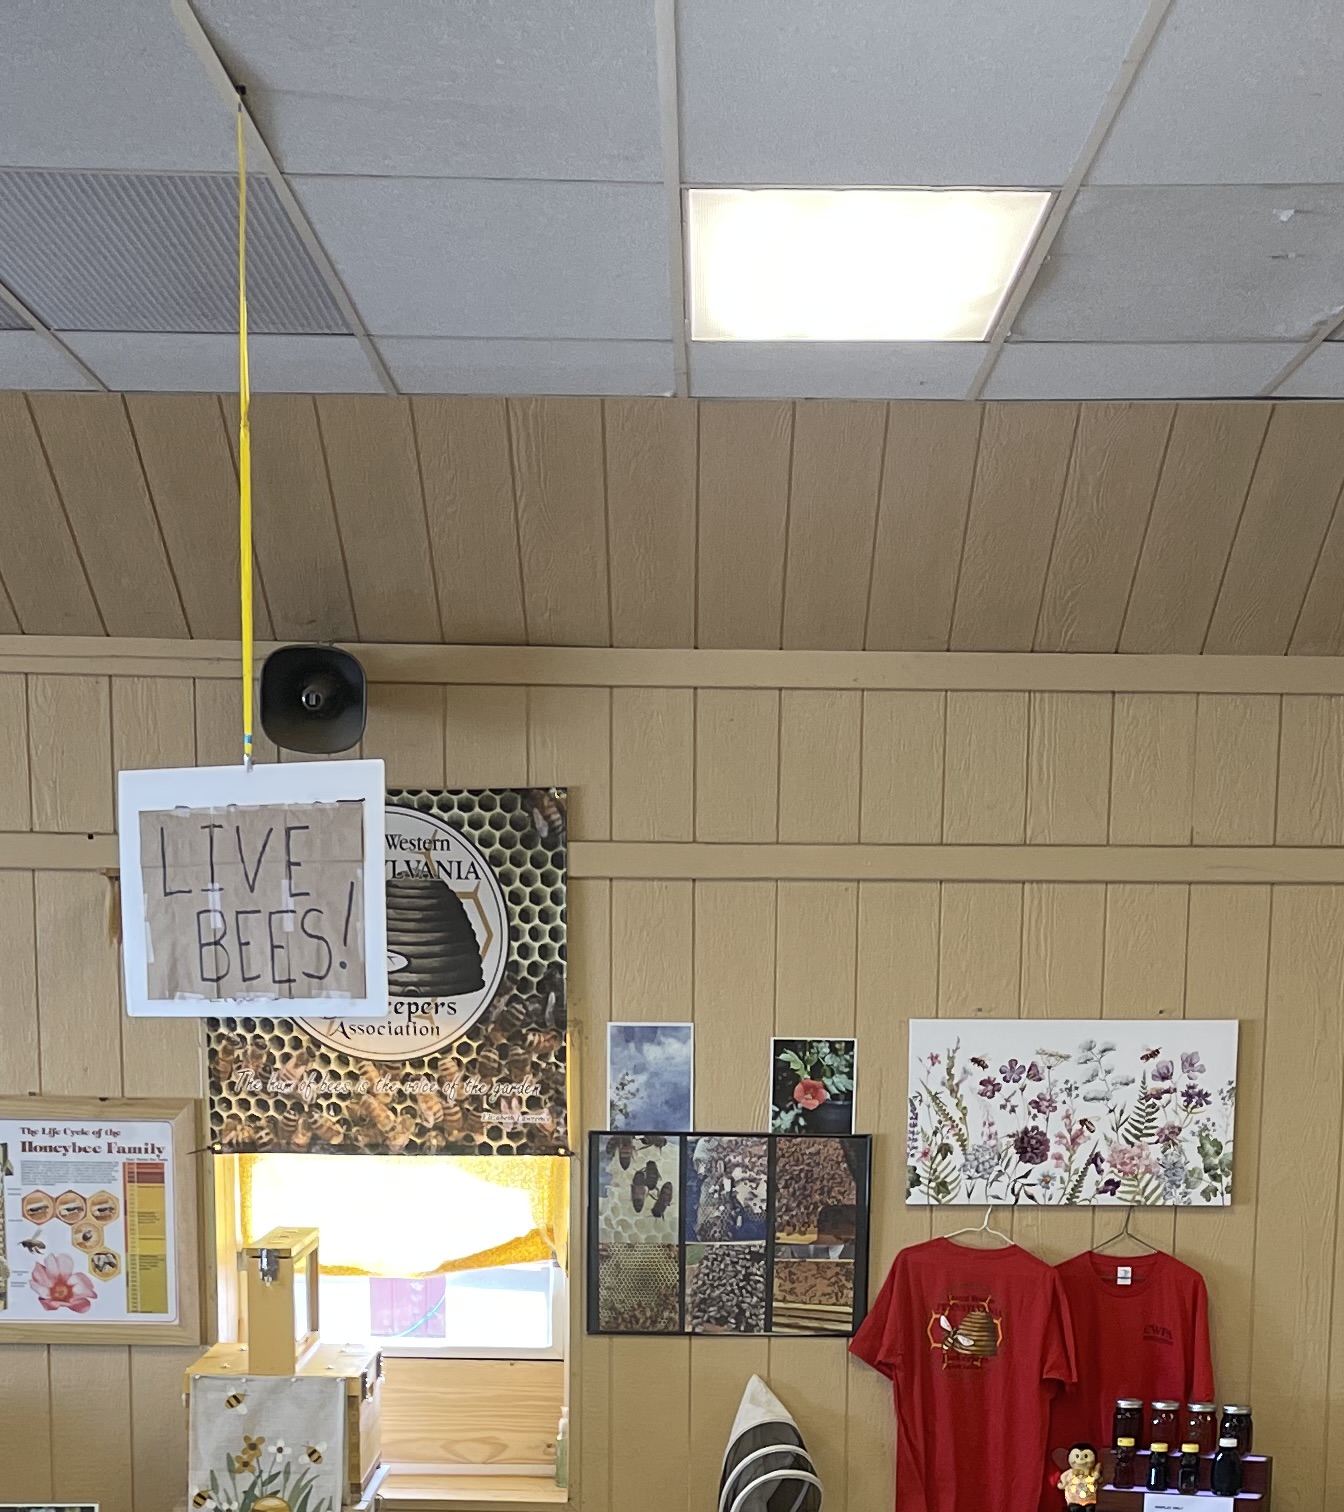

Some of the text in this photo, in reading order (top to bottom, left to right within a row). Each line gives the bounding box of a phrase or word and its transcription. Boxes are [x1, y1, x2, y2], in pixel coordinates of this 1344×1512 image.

[385, 833, 451, 852] Western
[159, 822, 311, 899] LIVE
[196, 880, 355, 985] BEES!
[388, 1000, 458, 1022] epers
[329, 1019, 441, 1040] Association
[233, 1068, 263, 1092] The
[298, 1071, 318, 1103] of
[319, 1072, 352, 1093] bees
[356, 1075, 370, 1093] is
[374, 1073, 398, 1092] the
[442, 1071, 464, 1100] of
[464, 1074, 487, 1094] the
[488, 1073, 541, 1103] garden
[19, 1127, 121, 1138] The Life Cycle of the
[19, 1141, 165, 1158] Honeybee Family
